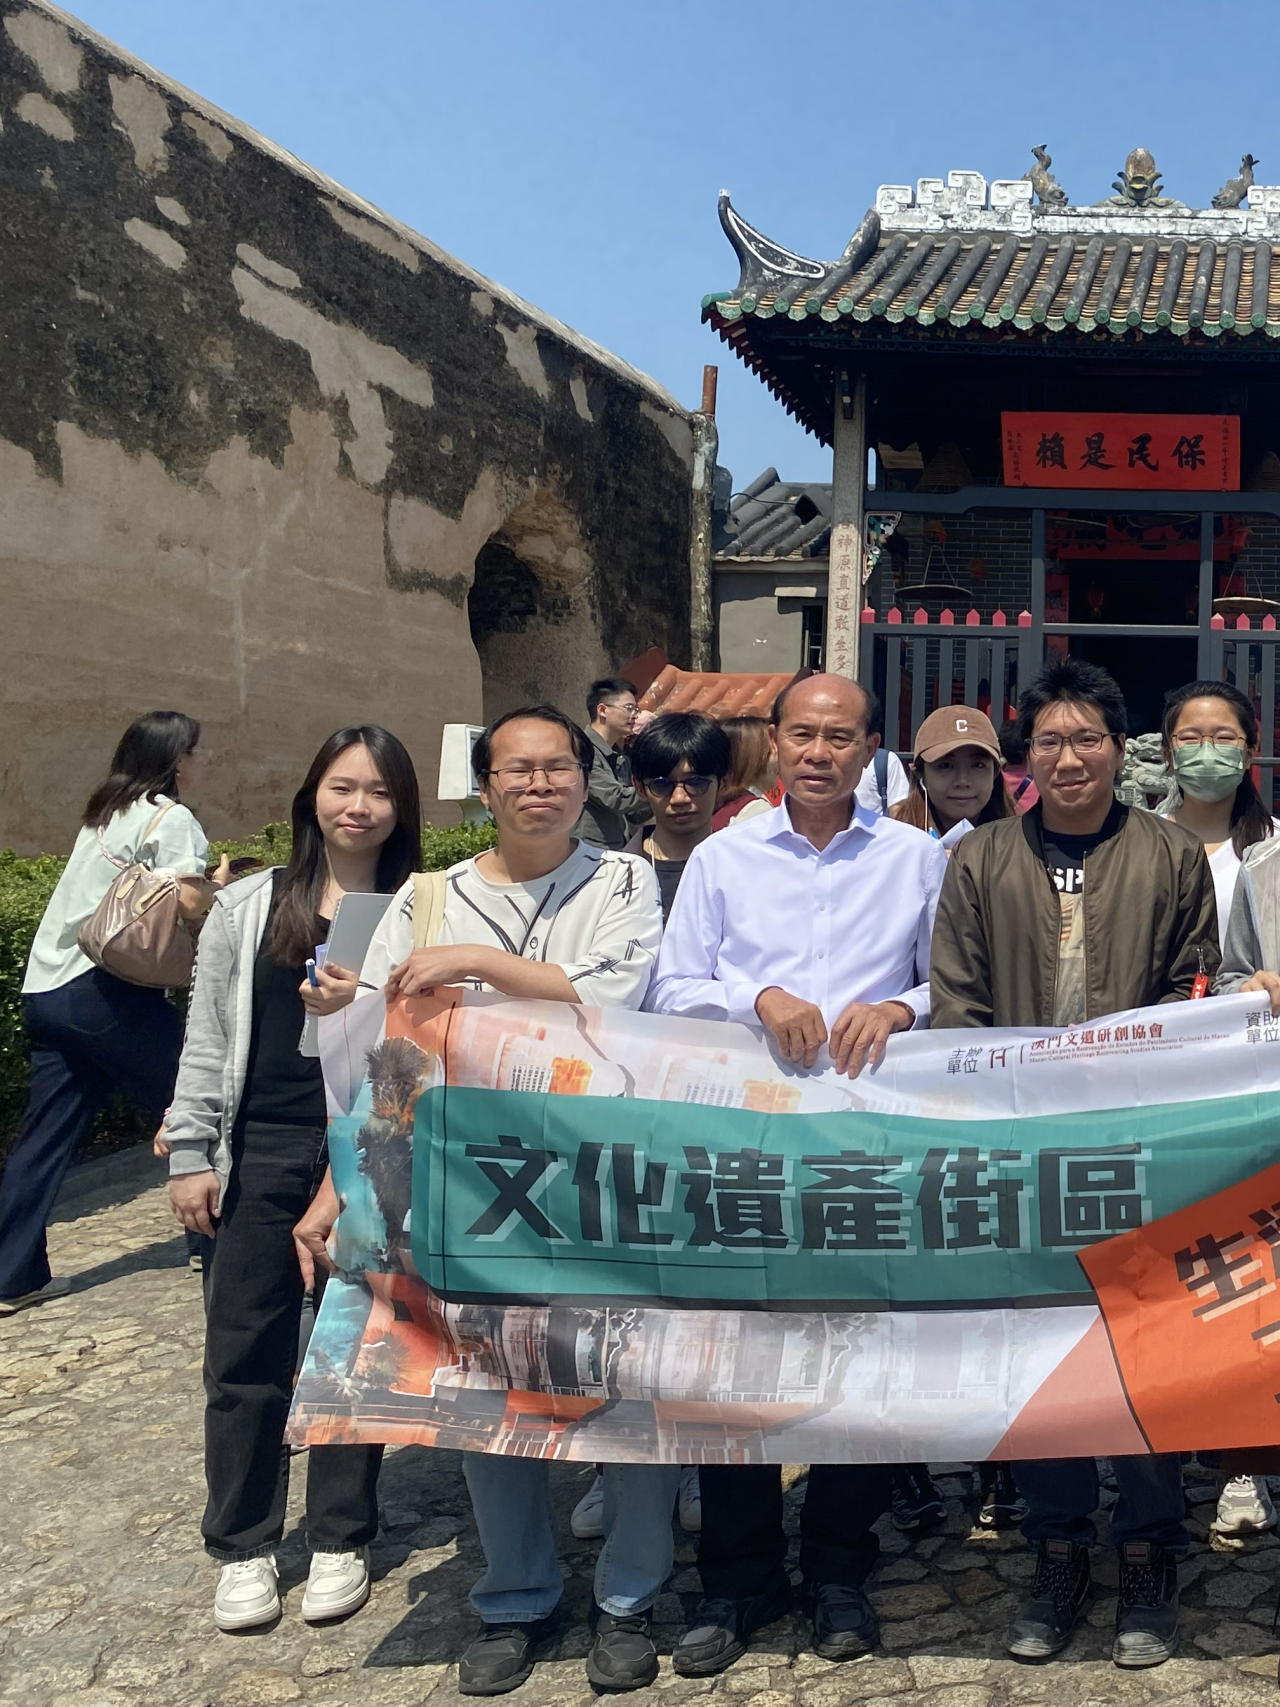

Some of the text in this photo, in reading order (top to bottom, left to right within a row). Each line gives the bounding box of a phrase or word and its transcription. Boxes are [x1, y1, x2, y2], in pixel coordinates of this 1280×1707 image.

[956, 720, 968, 732] C
[1245, 1011, 1279, 1029] 資助
[1246, 1028, 1280, 1044] 單位
[946, 1058, 978, 1075] 單位
[465, 1135, 1148, 1252] 文化遺產街區
